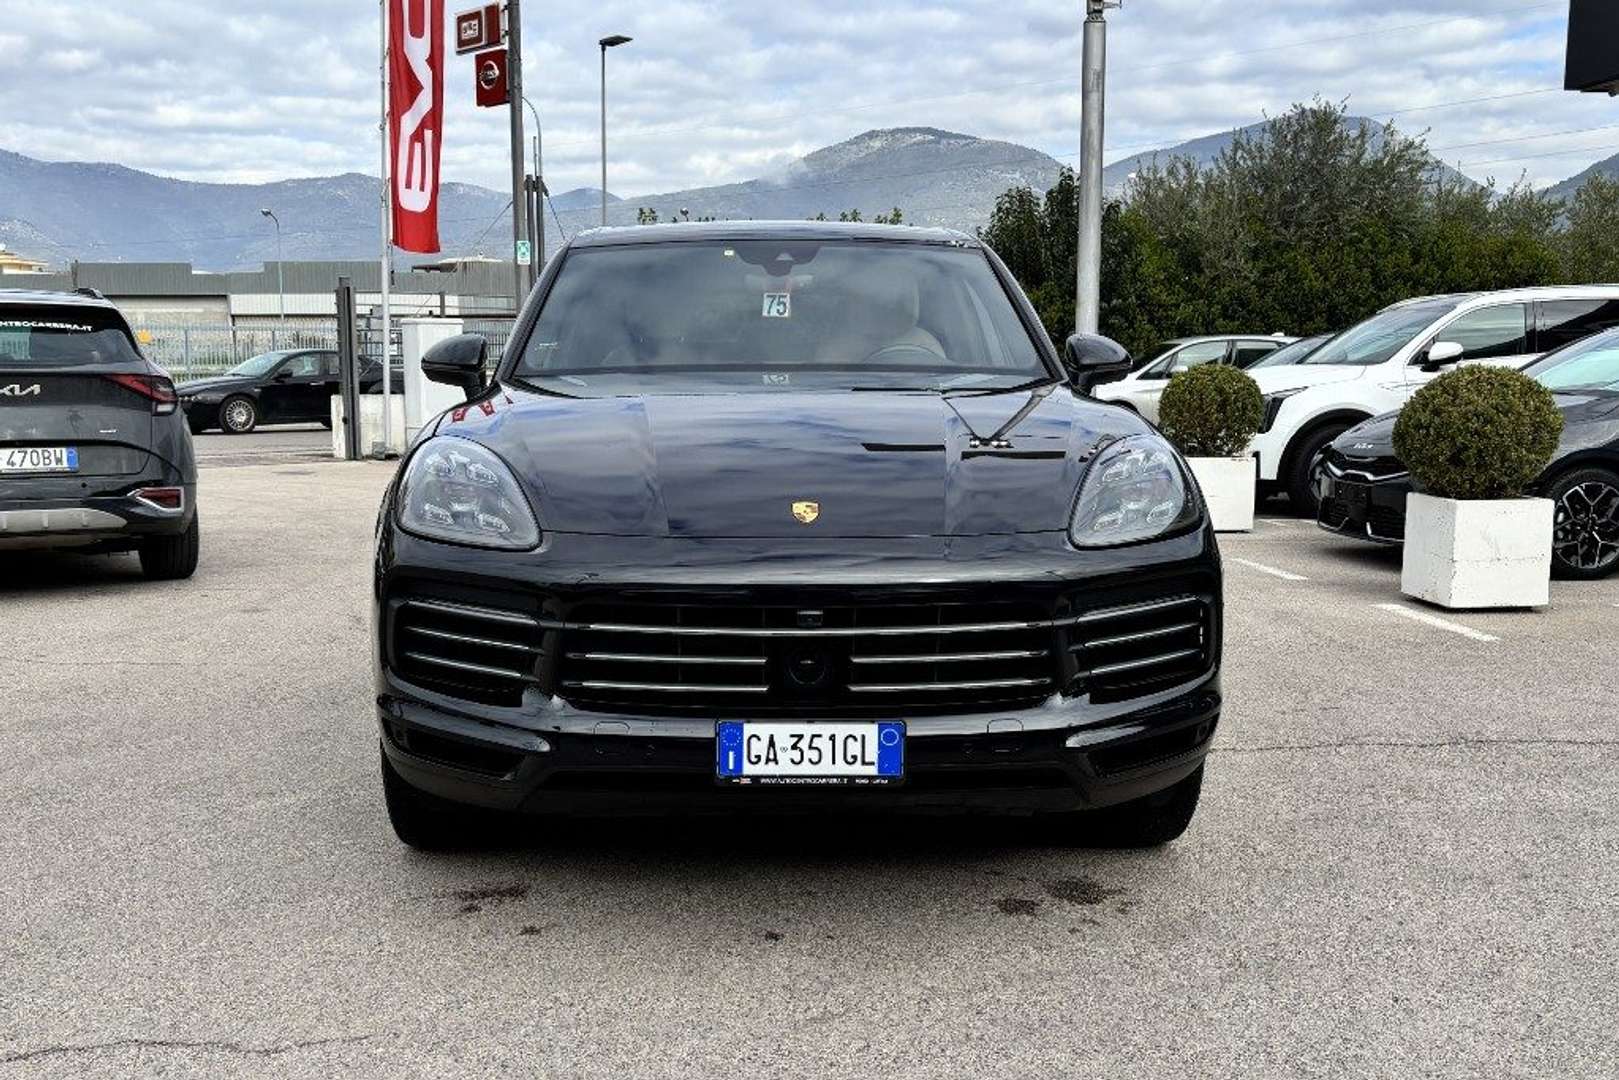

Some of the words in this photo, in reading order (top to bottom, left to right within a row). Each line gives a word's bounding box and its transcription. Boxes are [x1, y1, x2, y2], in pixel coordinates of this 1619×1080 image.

[766, 294, 788, 316] 75
[6, 449, 64, 467] 470BW
[746, 734, 779, 765] GA
[789, 734, 876, 766] 351GL
